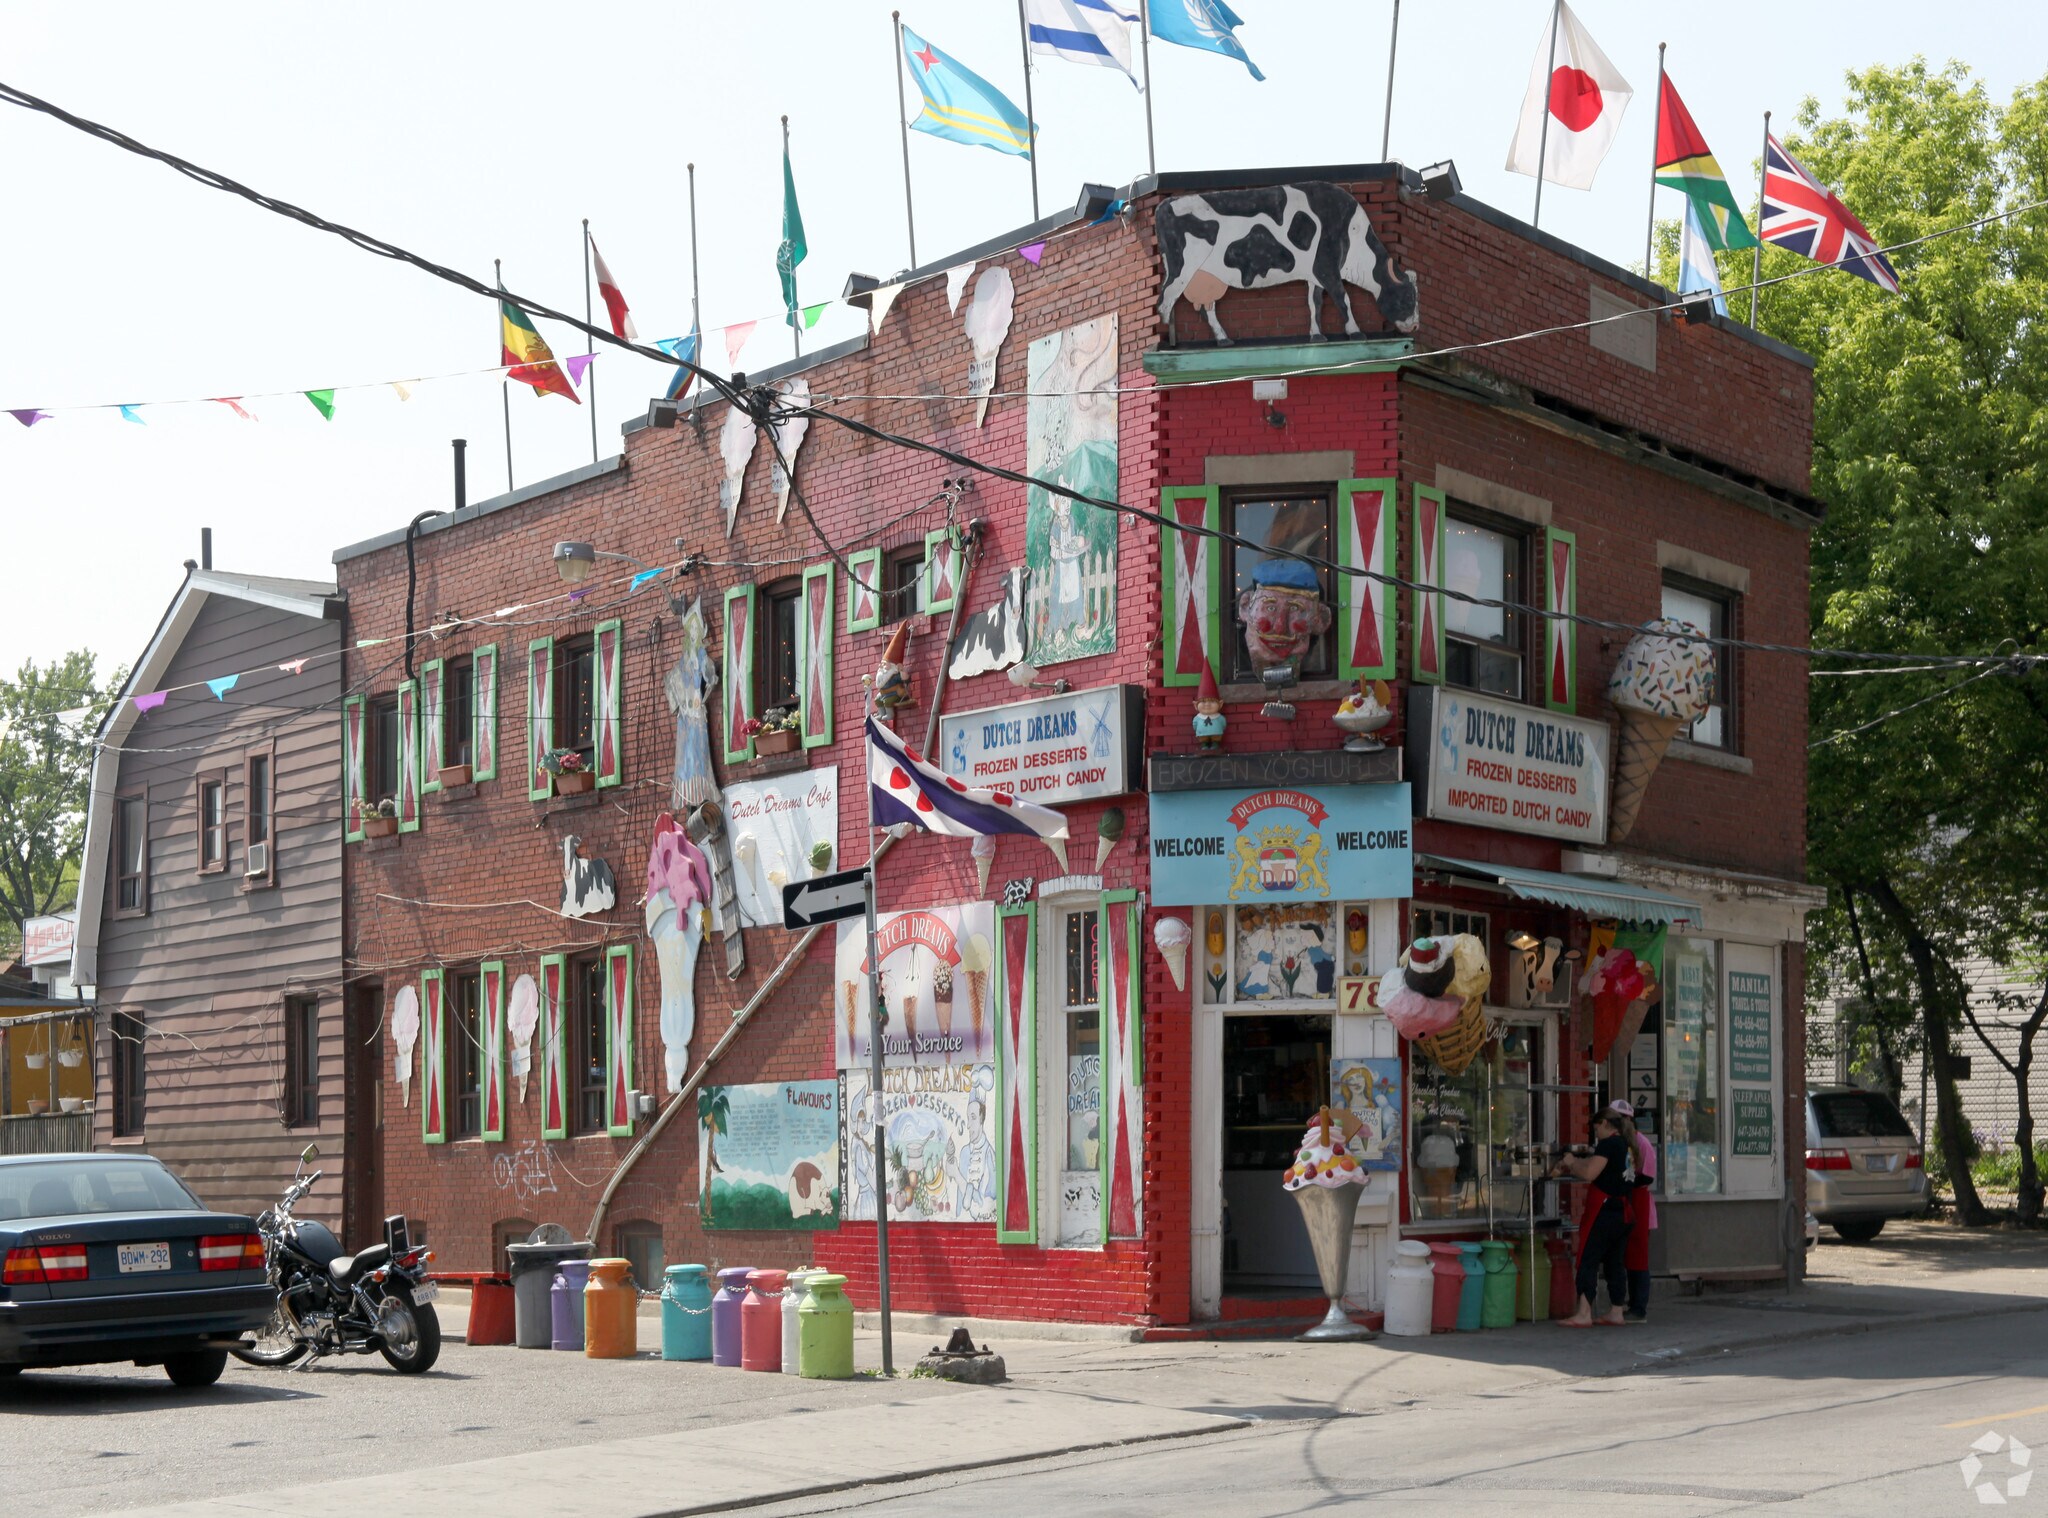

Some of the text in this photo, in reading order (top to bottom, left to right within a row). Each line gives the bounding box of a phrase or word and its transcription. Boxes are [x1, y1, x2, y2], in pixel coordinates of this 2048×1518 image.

[983, 710, 1077, 750] DUTCH DREAMS
[1465, 707, 1585, 768] DUTCH DREAMS
[974, 746, 1088, 777] FROZEN DESSERTS
[1020, 774, 1061, 793] DUTCH
[1066, 767, 1107, 786] CANDY
[1467, 758, 1577, 795] FROZEN DESSERTS
[732, 785, 832, 820] Dutch Dreams Cafe
[1236, 792, 1319, 819] DUTCH DREAMS
[1448, 788, 1592, 829] IMPORTED DUTCH CANDY
[1154, 837, 1225, 857] WELCOME
[1336, 830, 1408, 850] WELCOME
[877, 917, 950, 956] UTCH DREAMS
[1345, 981, 1380, 1009] 78
[1732, 976, 1769, 994] MANILA
[1732, 996, 1750, 1012] TRAVEL
[1755, 998, 1769, 1013] TOURS
[881, 1034, 912, 1055] Your
[915, 1030, 963, 1053] Service
[914, 1064, 973, 1093] DREAMS
[1070, 1057, 1100, 1087] DUTC
[786, 1086, 833, 1110] FLAVOURS
[839, 1075, 847, 1122] OPEN
[1440, 1103, 1465, 1117] Chocolate
[1734, 1090, 1753, 1103] SLEEP
[916, 1093, 965, 1136] DESSERTS
[1741, 1106, 1767, 1118] SUPPLIES
[840, 1127, 848, 1164] ALL
[38, 1233, 71, 1241] VOLVO
[150, 1249, 169, 1263] 292
